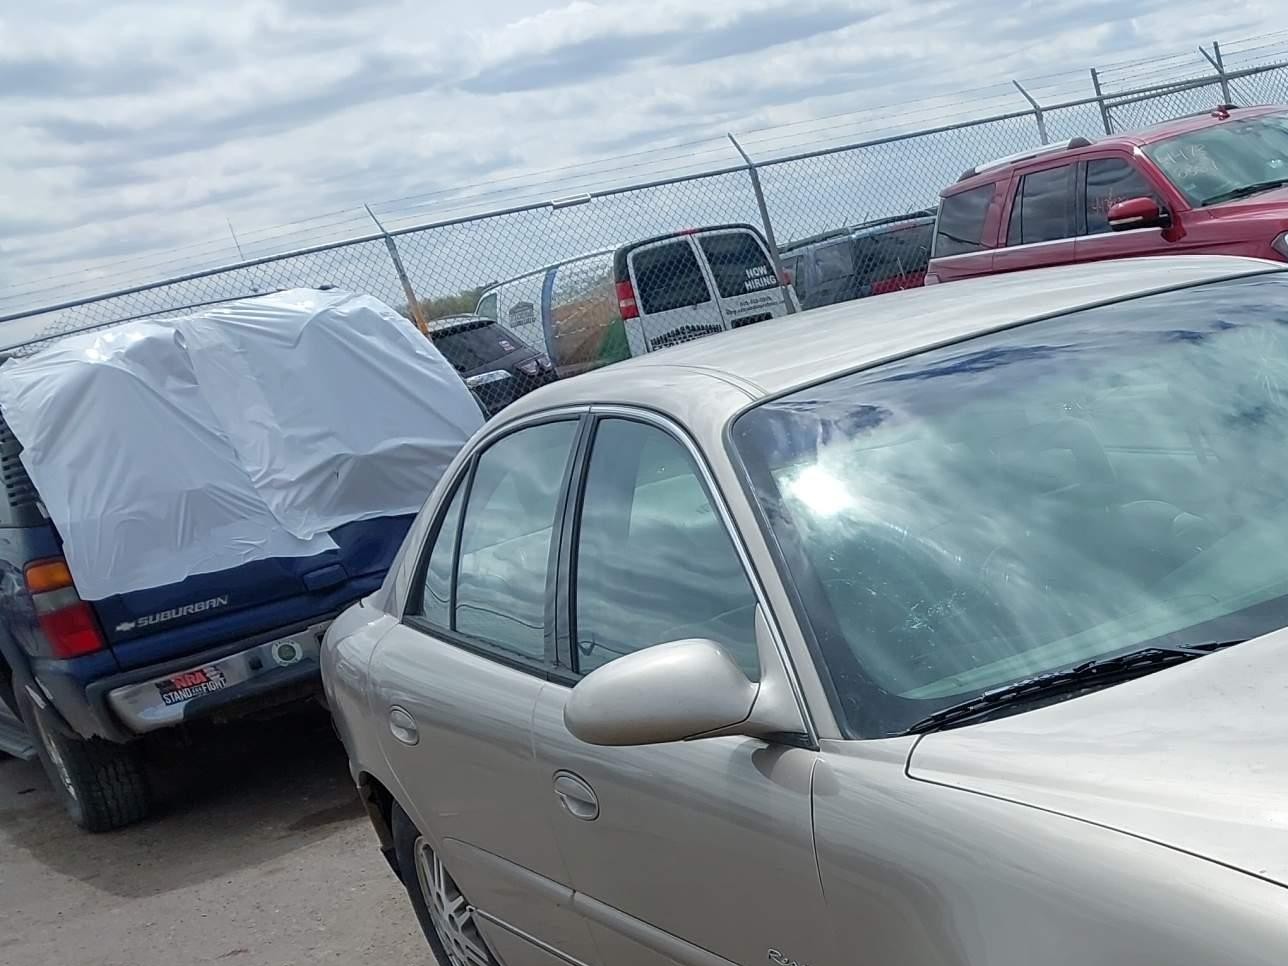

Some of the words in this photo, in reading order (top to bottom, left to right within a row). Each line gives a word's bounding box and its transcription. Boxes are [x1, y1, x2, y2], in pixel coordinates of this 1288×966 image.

[745, 265, 768, 278] NOW
[744, 275, 777, 290] HIRING
[137, 595, 229, 628] SUBURBAN
[174, 671, 207, 689] NRA
[163, 687, 193, 704] STAND
